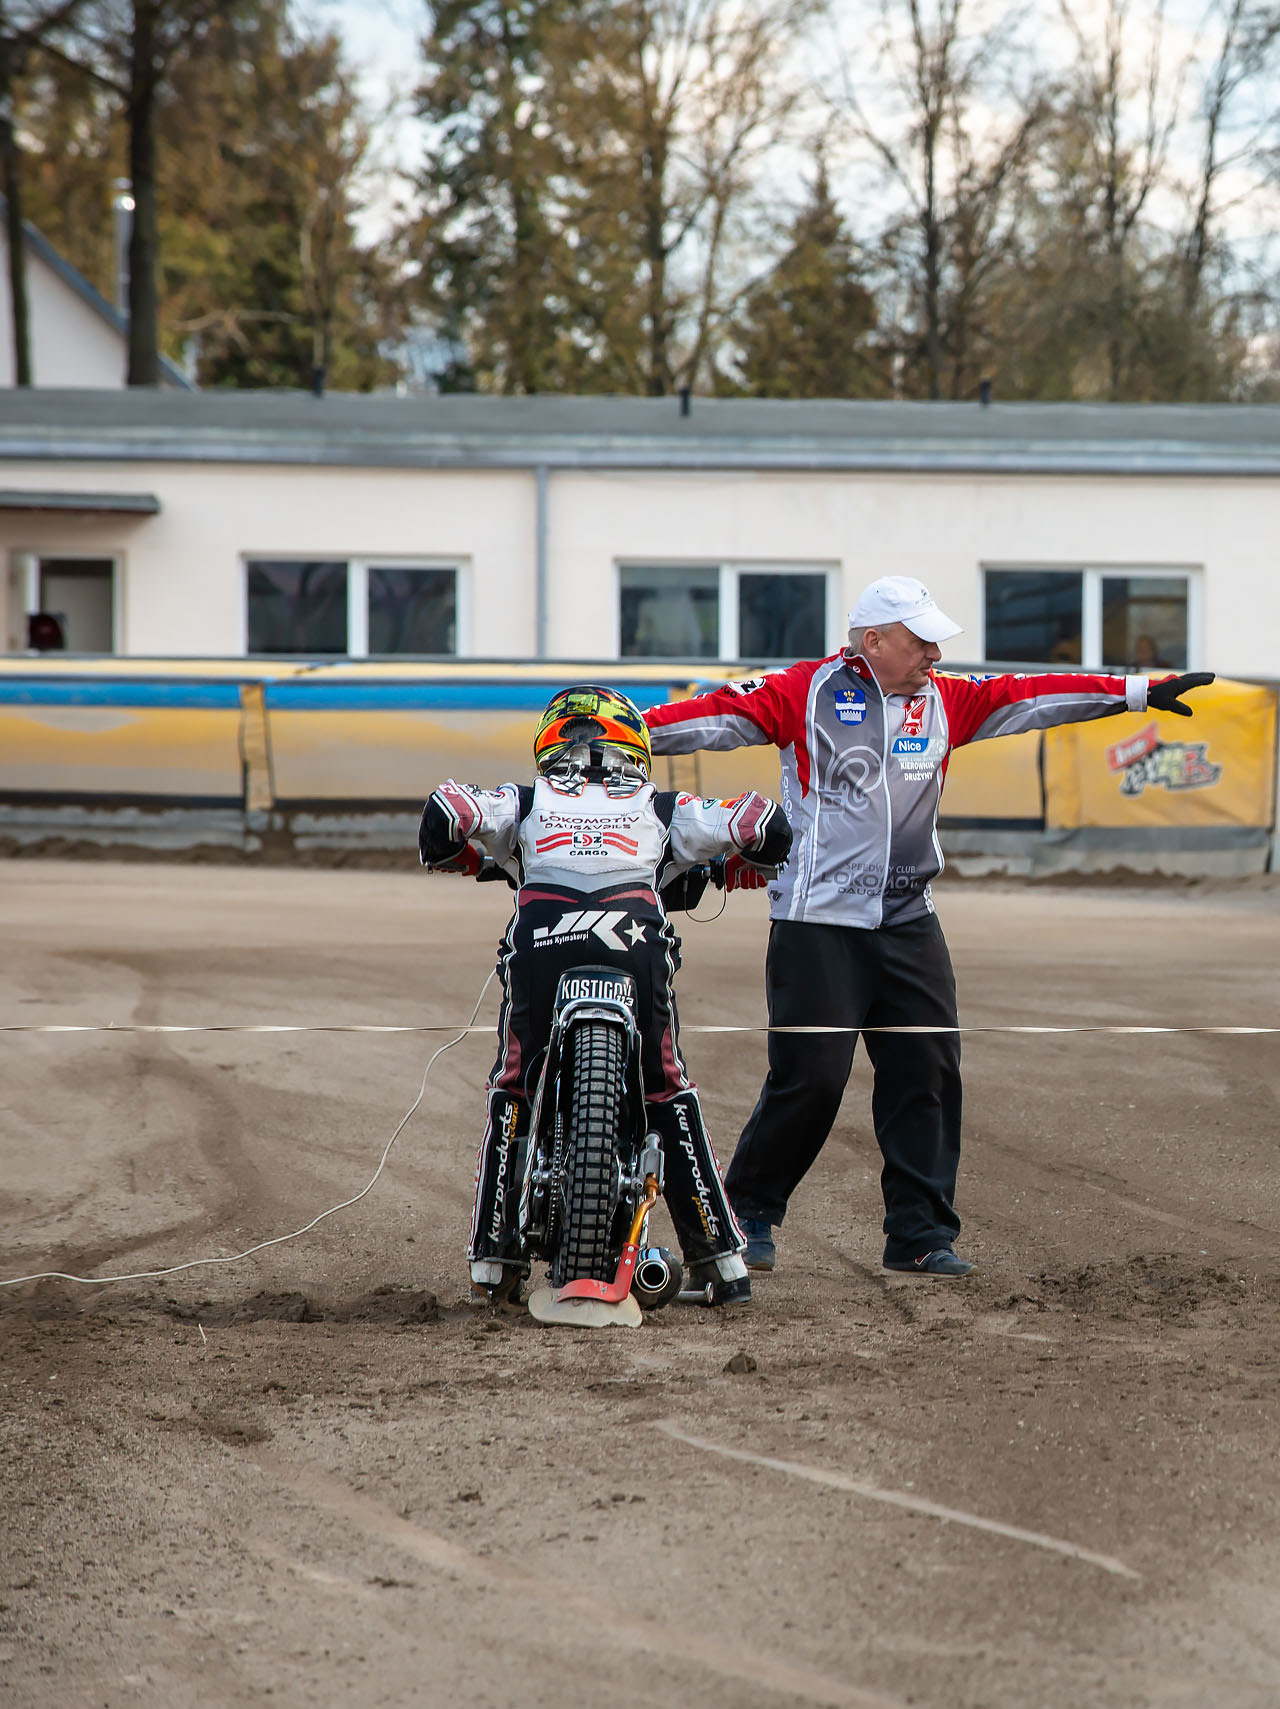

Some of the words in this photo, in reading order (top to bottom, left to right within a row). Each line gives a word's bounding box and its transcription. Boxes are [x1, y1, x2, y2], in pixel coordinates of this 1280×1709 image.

[898, 740, 921, 751] Nice
[544, 822, 636, 831] DAUGAVPILS
[846, 862, 893, 872] SPEEDWY
[896, 865, 916, 874] CLUB
[616, 995, 634, 1007] 113
[487, 1101, 513, 1242] kw-products
[673, 1103, 720, 1238] kw-products
